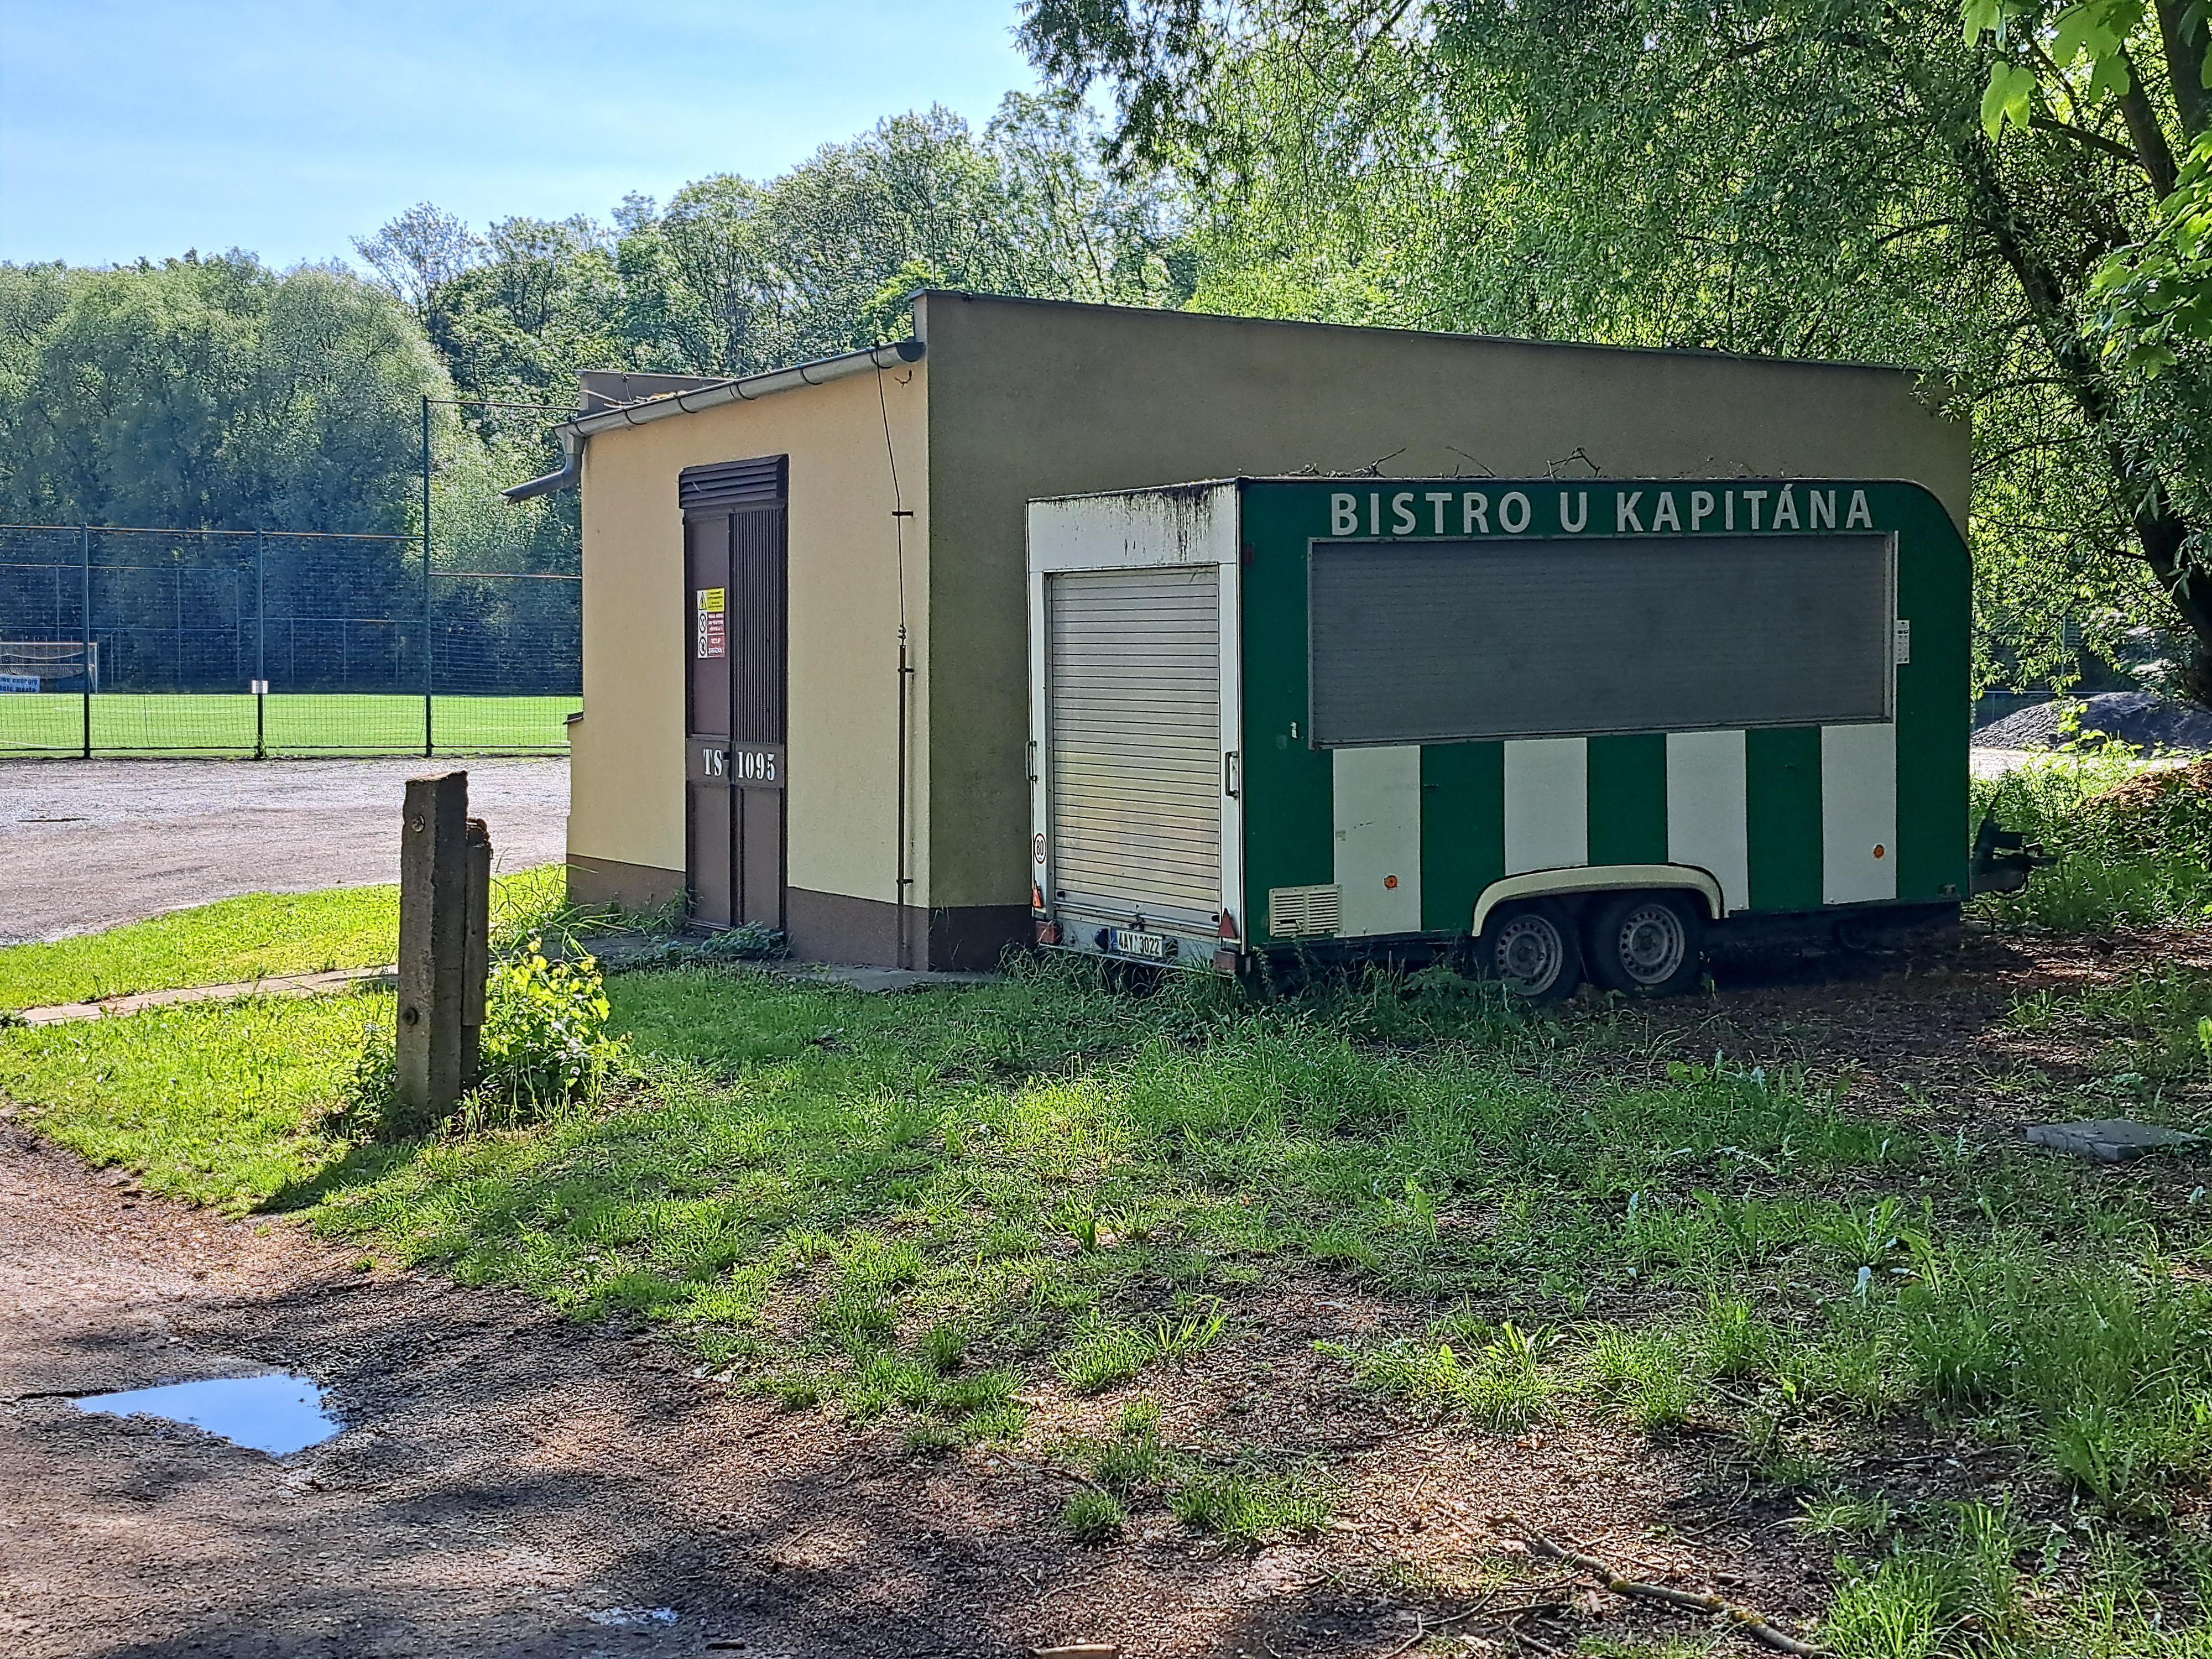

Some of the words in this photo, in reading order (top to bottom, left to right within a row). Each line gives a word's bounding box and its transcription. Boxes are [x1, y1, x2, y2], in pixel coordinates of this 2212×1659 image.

[1331, 491, 1532, 535] BISTRO
[1559, 491, 1588, 533] U
[1616, 483, 1873, 532] KAPITÁNA
[702, 748, 723, 776] TS
[738, 751, 776, 781] 1095
[1036, 839, 1044, 856] 80
[1119, 932, 1133, 951] 4AY
[1139, 936, 1160, 954] 3022
